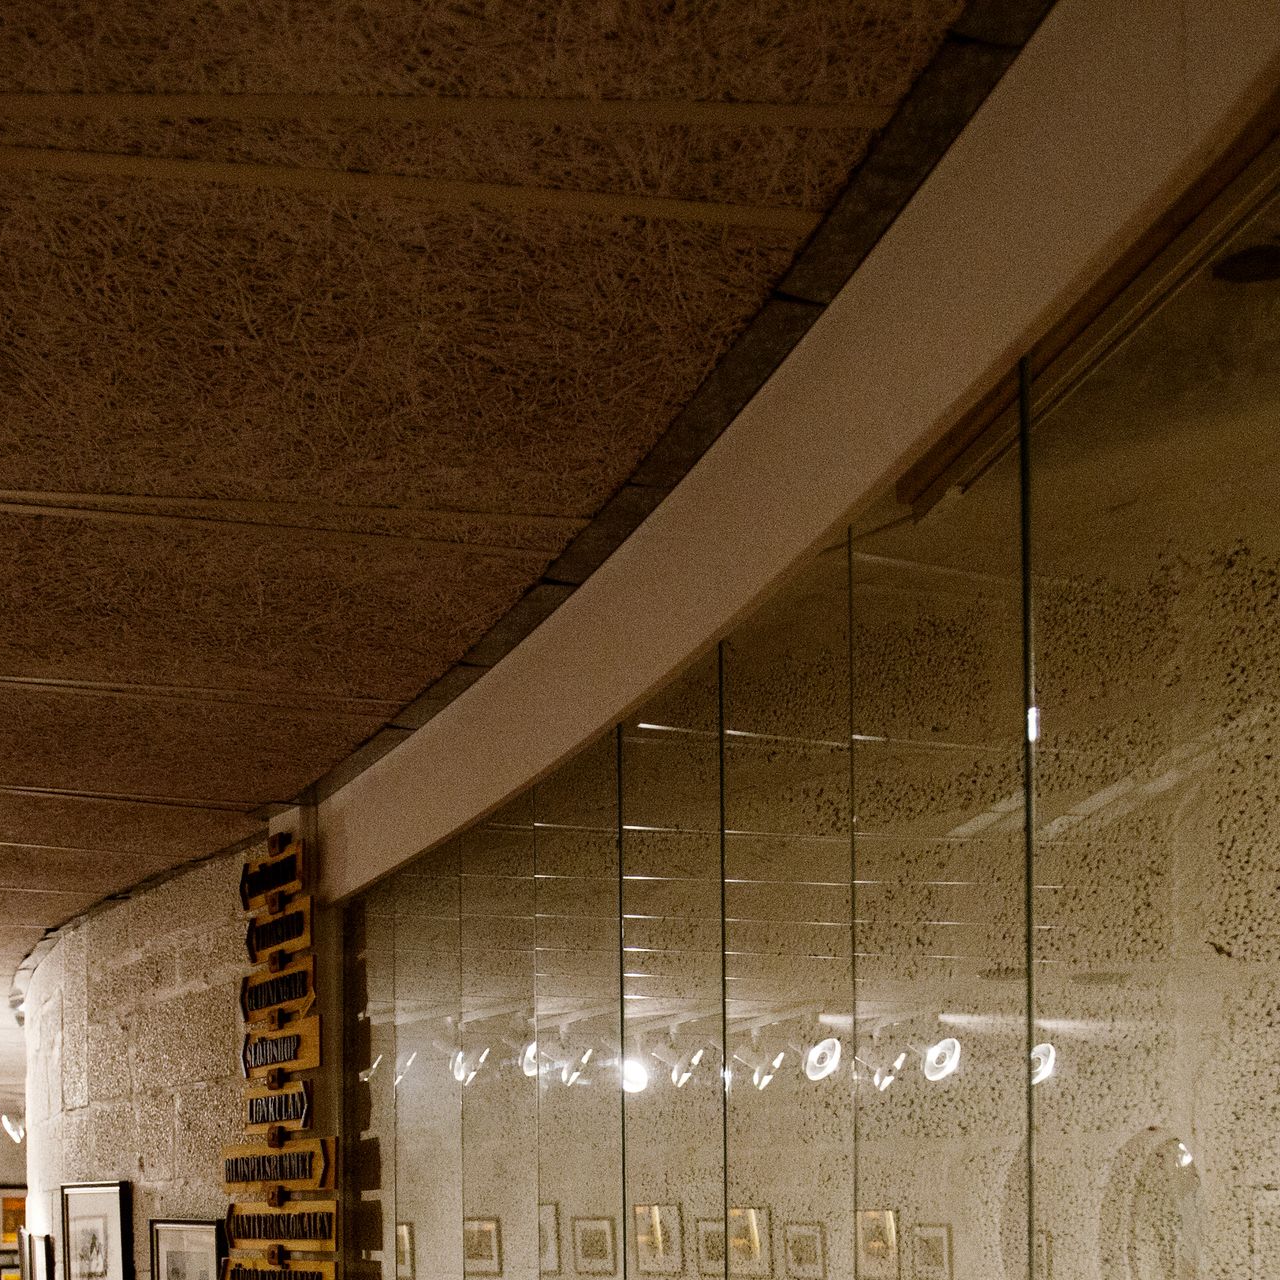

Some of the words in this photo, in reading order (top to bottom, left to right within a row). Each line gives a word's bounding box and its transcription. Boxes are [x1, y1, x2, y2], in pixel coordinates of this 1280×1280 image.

[246, 1035, 298, 1069] SLÖJDSHOP
[248, 1093, 303, 1123] LIONKULAN
[225, 1152, 312, 1182] BILDSPELSRUMMET
[231, 1212, 332, 1239] HANTVERKSLOKALEN
